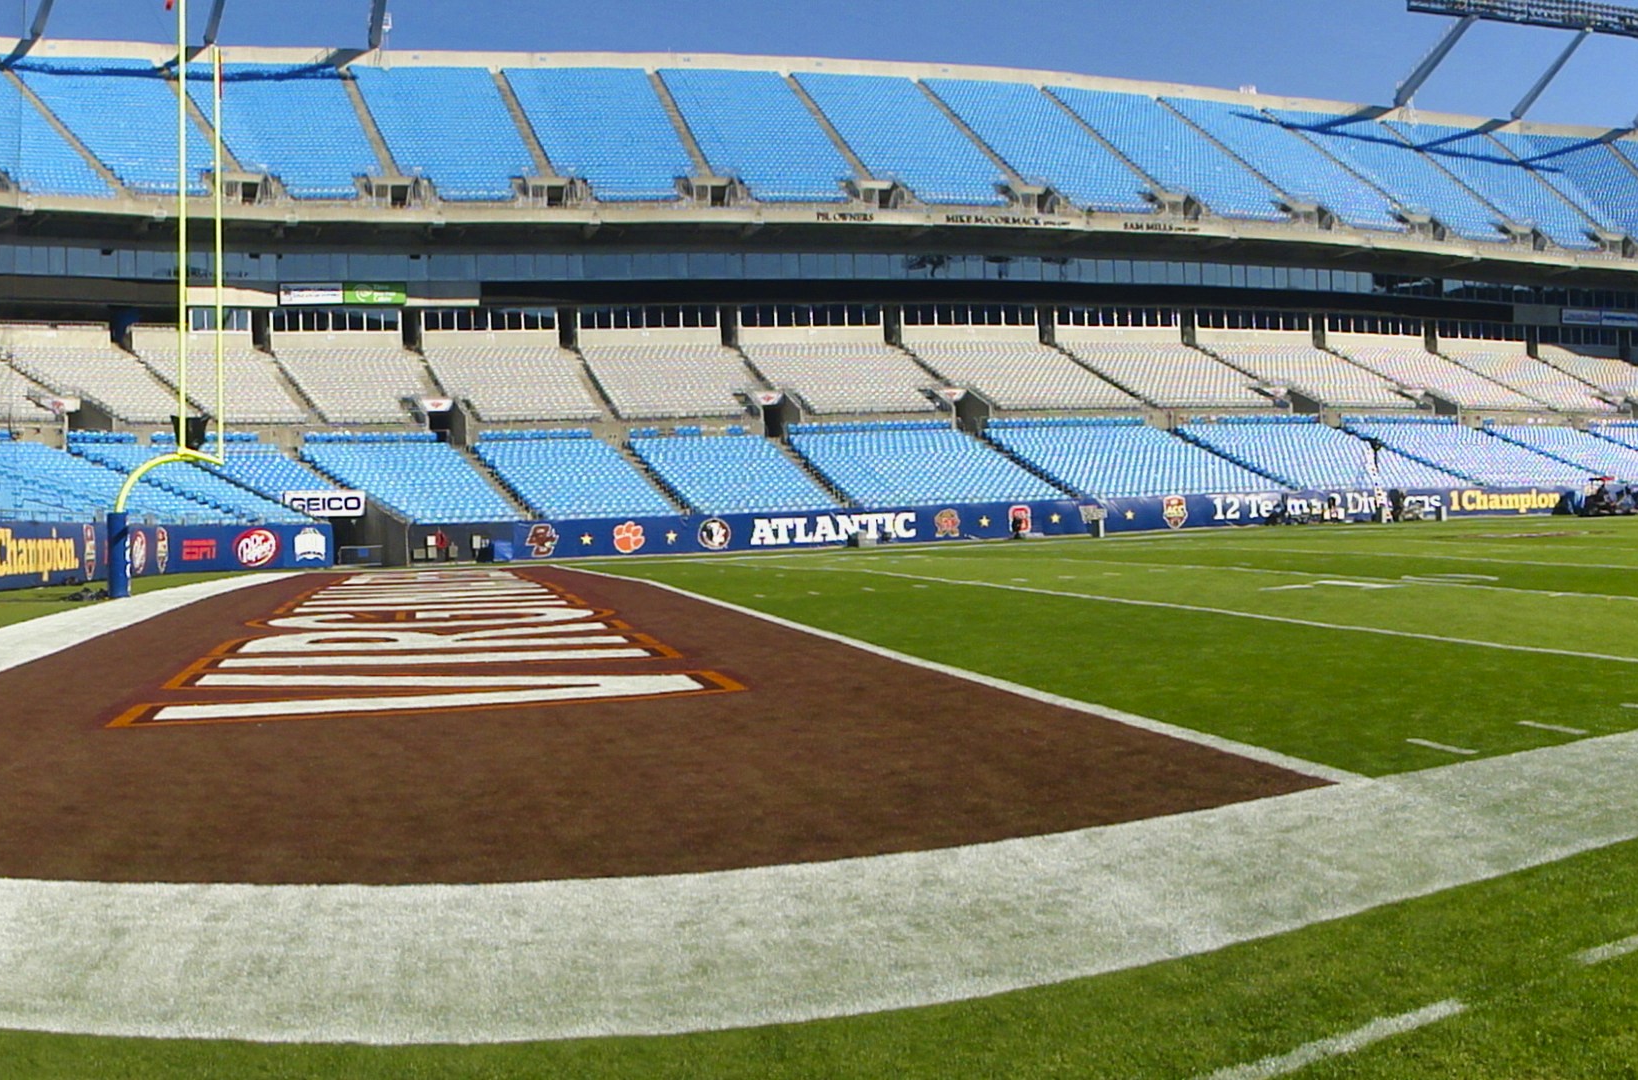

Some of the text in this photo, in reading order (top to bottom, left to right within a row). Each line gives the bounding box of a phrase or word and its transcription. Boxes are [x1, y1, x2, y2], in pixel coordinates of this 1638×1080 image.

[946, 214, 971, 224] MIKE
[291, 496, 362, 513] GEICO
[1166, 503, 1185, 516] ACC
[1213, 492, 1240, 521] 12
[1450, 490, 1462, 512] 1
[750, 511, 917, 546] ATLANTIC
[182, 538, 216, 562] ESPN
